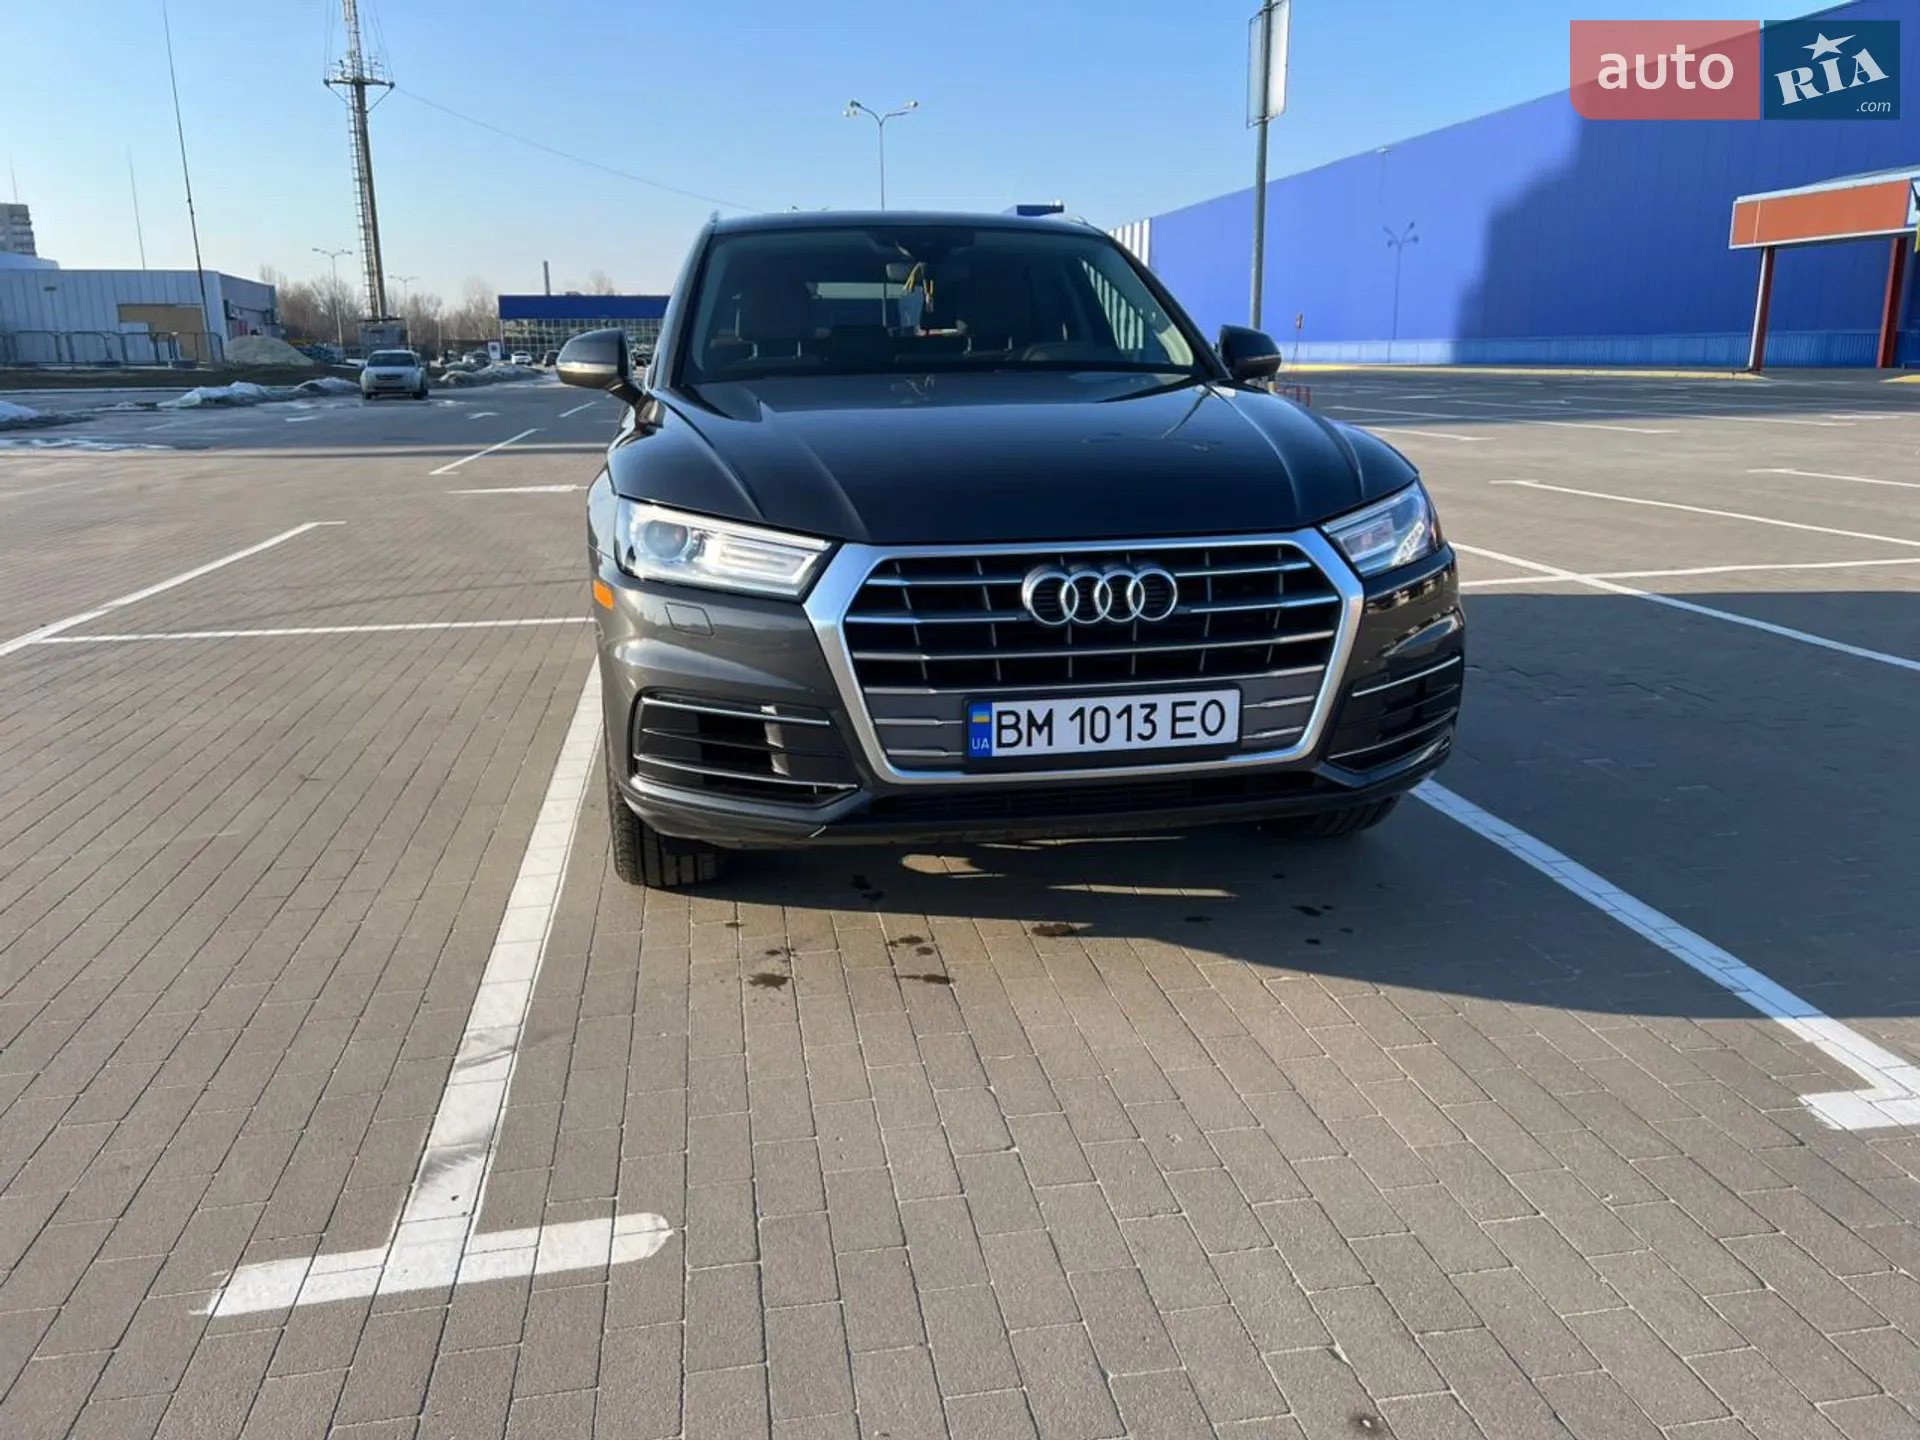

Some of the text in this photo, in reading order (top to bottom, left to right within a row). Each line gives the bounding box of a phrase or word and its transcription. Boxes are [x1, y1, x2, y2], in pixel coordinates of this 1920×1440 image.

[996, 699, 1226, 748] BM 1013 EO
[971, 737, 990, 750] UA
